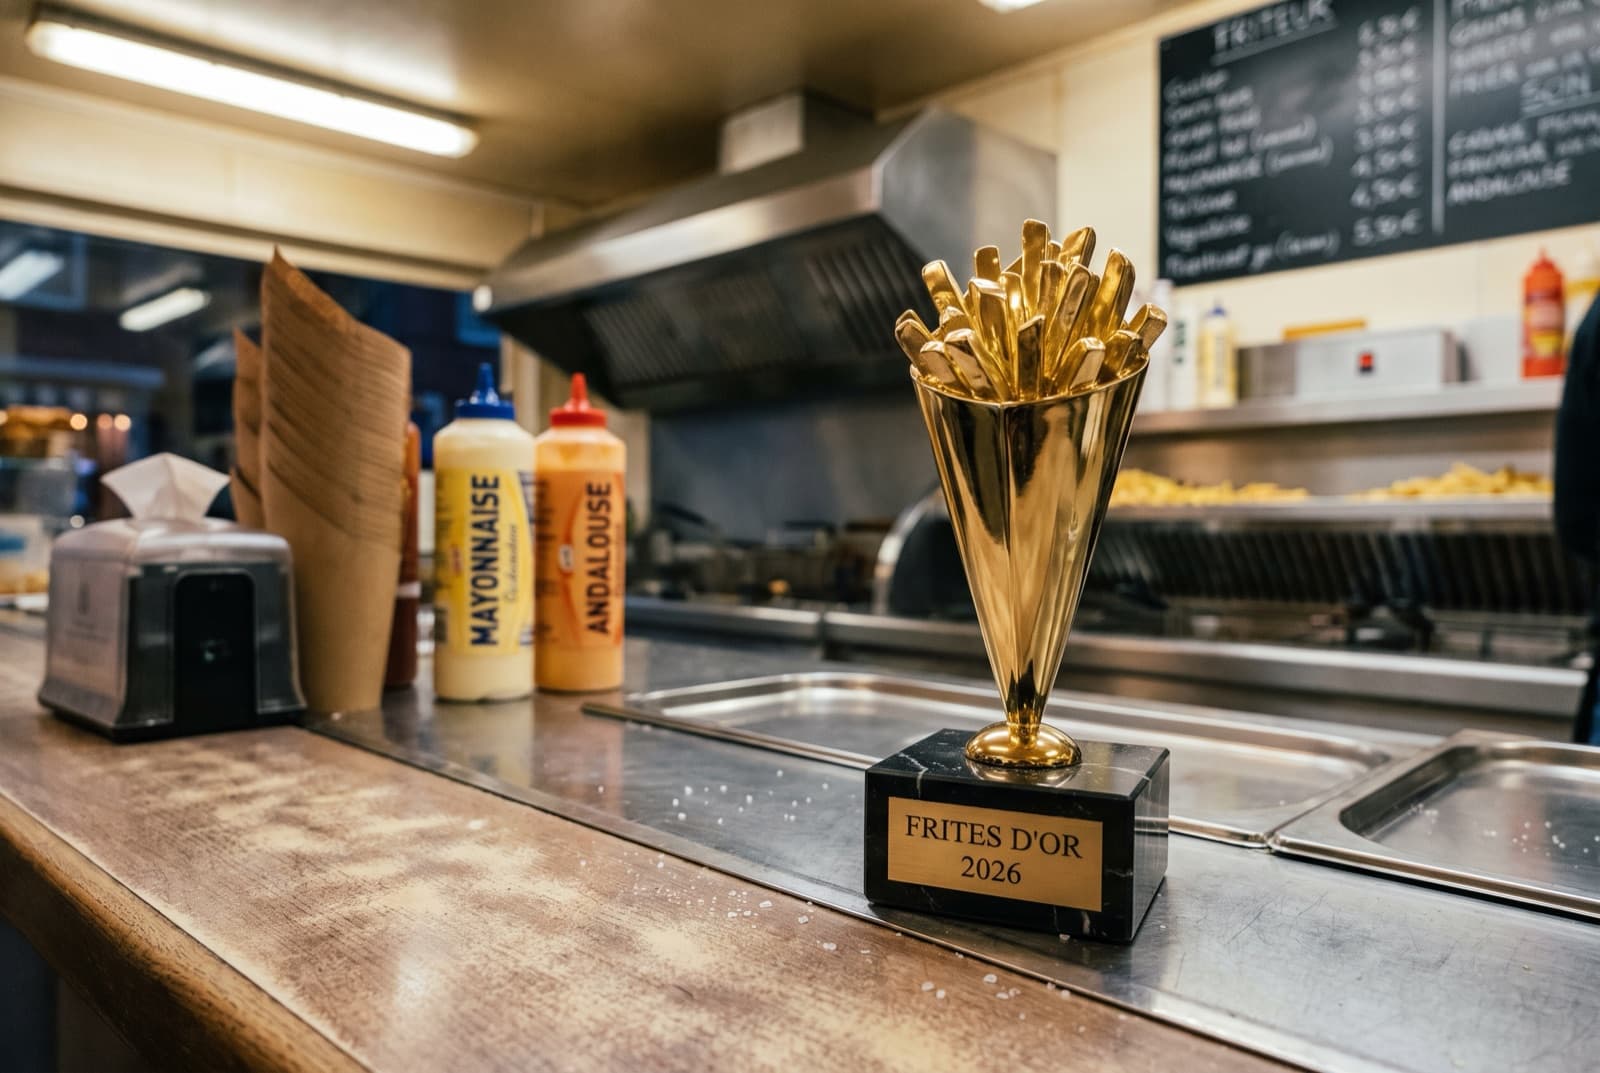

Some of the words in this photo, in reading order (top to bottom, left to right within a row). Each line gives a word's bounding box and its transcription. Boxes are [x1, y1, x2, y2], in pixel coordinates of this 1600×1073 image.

[470, 474, 499, 646] MAYONNAISE
[586, 482, 611, 636] ANDALOUSE
[905, 814, 1002, 849] FRITES
[1010, 827, 1082, 859] D'OR
[961, 855, 1022, 885] 2026
